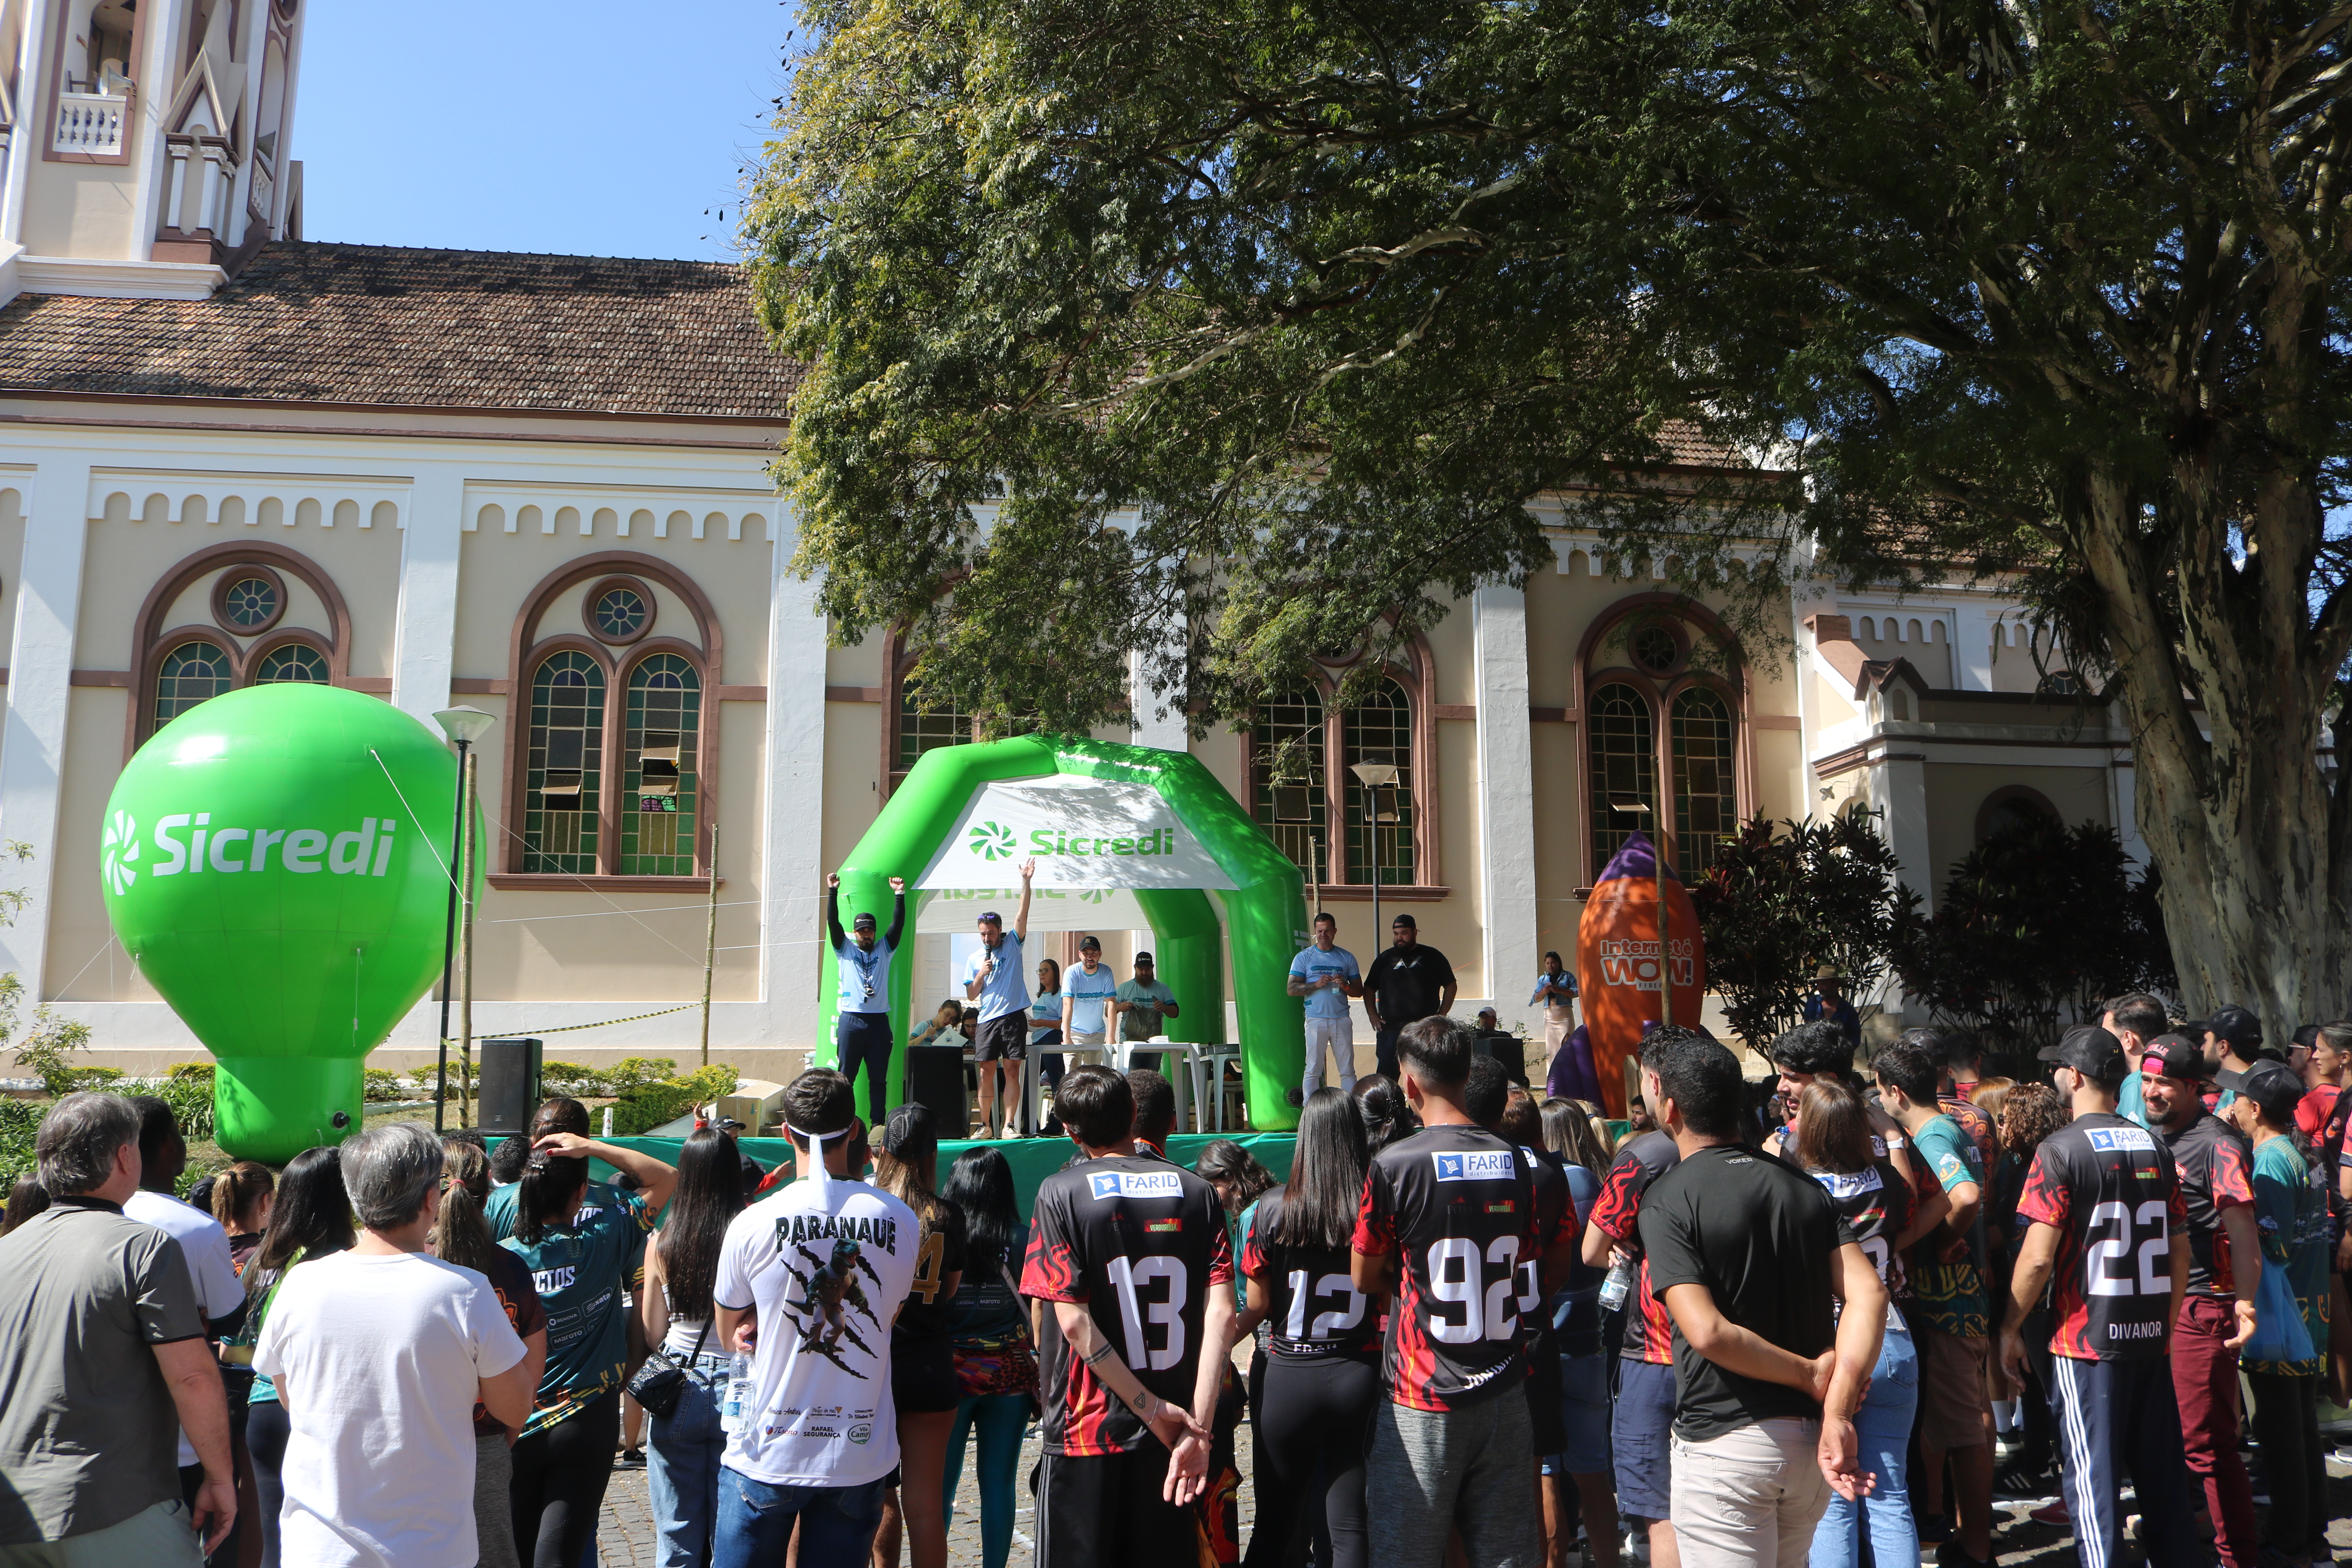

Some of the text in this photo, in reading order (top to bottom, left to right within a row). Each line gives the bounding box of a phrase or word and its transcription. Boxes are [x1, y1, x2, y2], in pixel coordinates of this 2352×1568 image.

[152, 812, 396, 877] Sicredi
[1029, 828, 1173, 856] Sicredi
[2114, 1131, 2149, 1143] FARID
[1468, 1155, 1512, 1171] FARID
[1126, 1175, 1178, 1189] FARID
[1840, 1168, 1877, 1188] FARID
[776, 1215, 896, 1257] PARANAUÊ
[2087, 1200, 2171, 1296] 22
[1427, 1235, 1519, 1344] 92
[557, 1313, 578, 1323] RENOVA
[1106, 1255, 1188, 1370] 13
[1285, 1269, 1367, 1341] 12
[2109, 1321, 2161, 1339] DIVANOR
